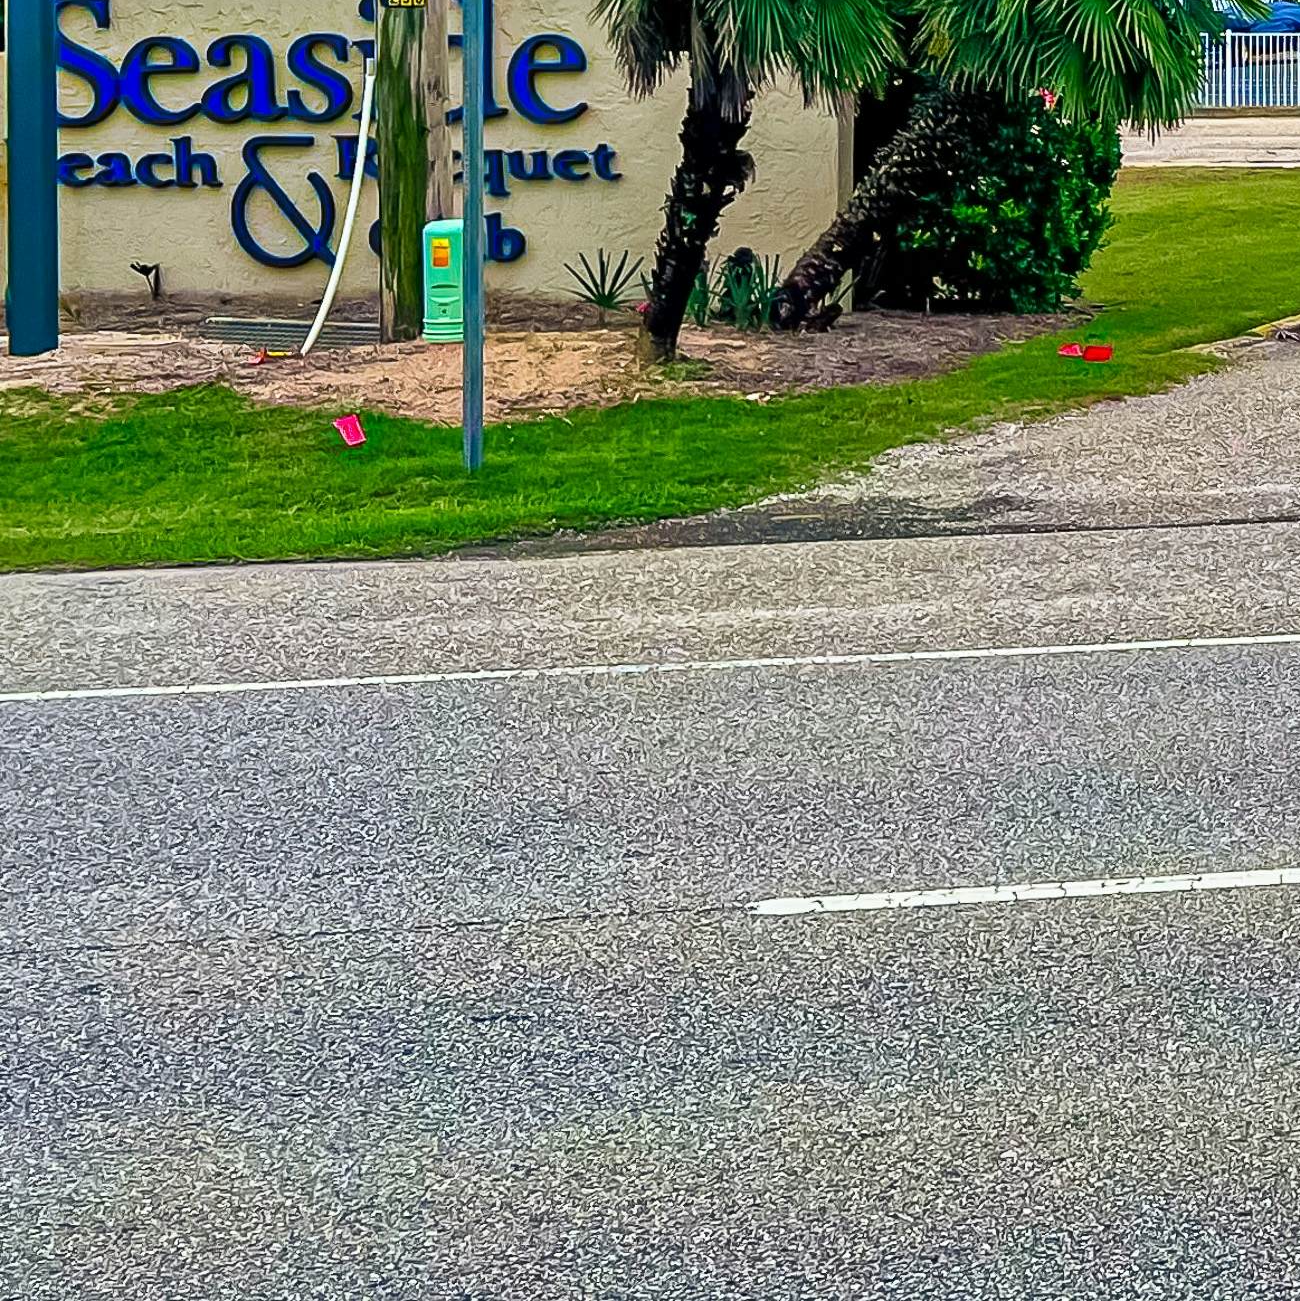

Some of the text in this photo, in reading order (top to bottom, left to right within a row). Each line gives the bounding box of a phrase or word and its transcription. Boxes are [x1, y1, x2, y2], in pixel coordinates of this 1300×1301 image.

[56, 136, 223, 188] each
[231, 134, 336, 268] &
[331, 134, 622, 198] Rquet
